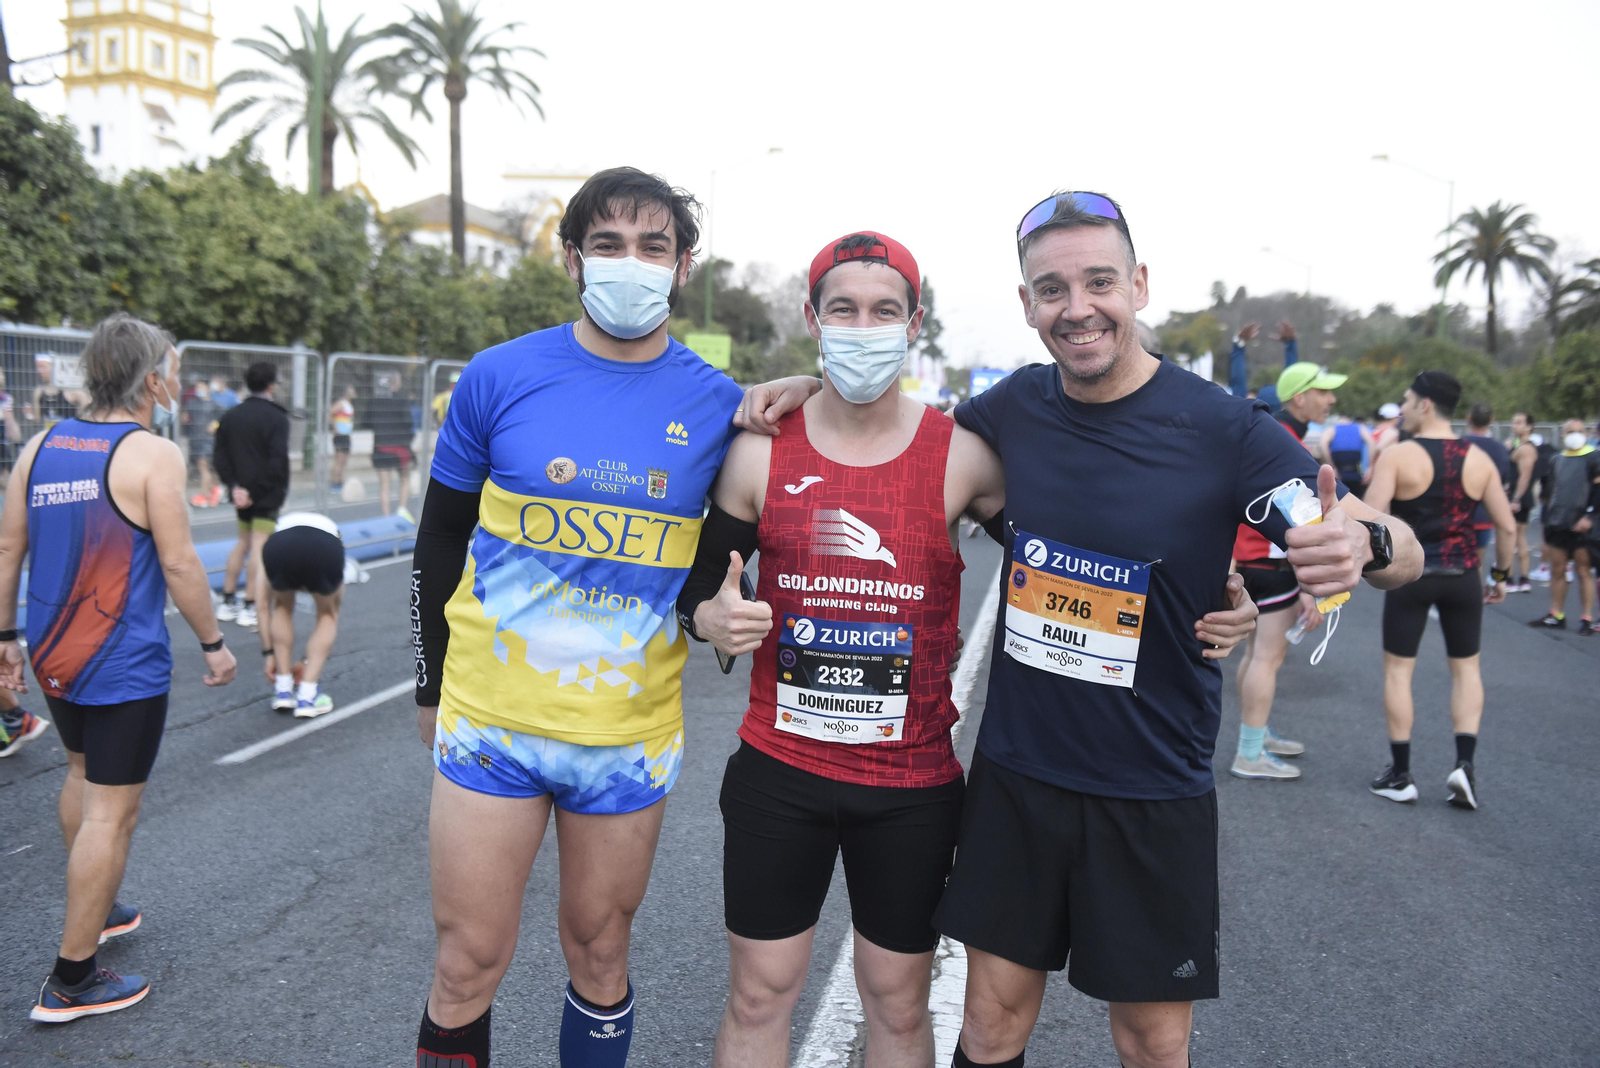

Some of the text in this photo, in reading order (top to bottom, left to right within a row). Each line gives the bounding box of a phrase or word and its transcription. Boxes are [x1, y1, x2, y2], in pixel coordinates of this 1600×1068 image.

[45, 435, 110, 453] JUANMA
[666, 437, 688, 446] mobel
[597, 459, 628, 472] CLUB
[579, 468, 644, 485] ATLETISMO
[33, 478, 99, 495] PUERTO REAL
[592, 481, 629, 495] OSSET
[46, 488, 99, 505] MARATON
[520, 502, 682, 562] OSSET
[1051, 552, 1130, 584] ZURICH
[777, 573, 925, 601] GOLONDRINOS
[1033, 572, 1049, 581] ZURICH
[1050, 577, 1073, 588] MARATÓN
[1081, 586, 1100, 595] SEVILLA
[531, 579, 642, 614] eMotion
[1045, 592, 1092, 619] 3746
[803, 598, 898, 615] RUNNING CLUB
[547, 605, 614, 631] running
[819, 628, 896, 647] ZURICH
[1042, 623, 1087, 648] RAULI
[820, 652, 844, 660] MARATÓN
[1013, 642, 1029, 653] asics
[818, 665, 864, 687] 2332
[798, 692, 884, 714] DOMÍNGUEZ
[792, 716, 807, 725] asics
[589, 1028, 626, 1039] NeoActiv
